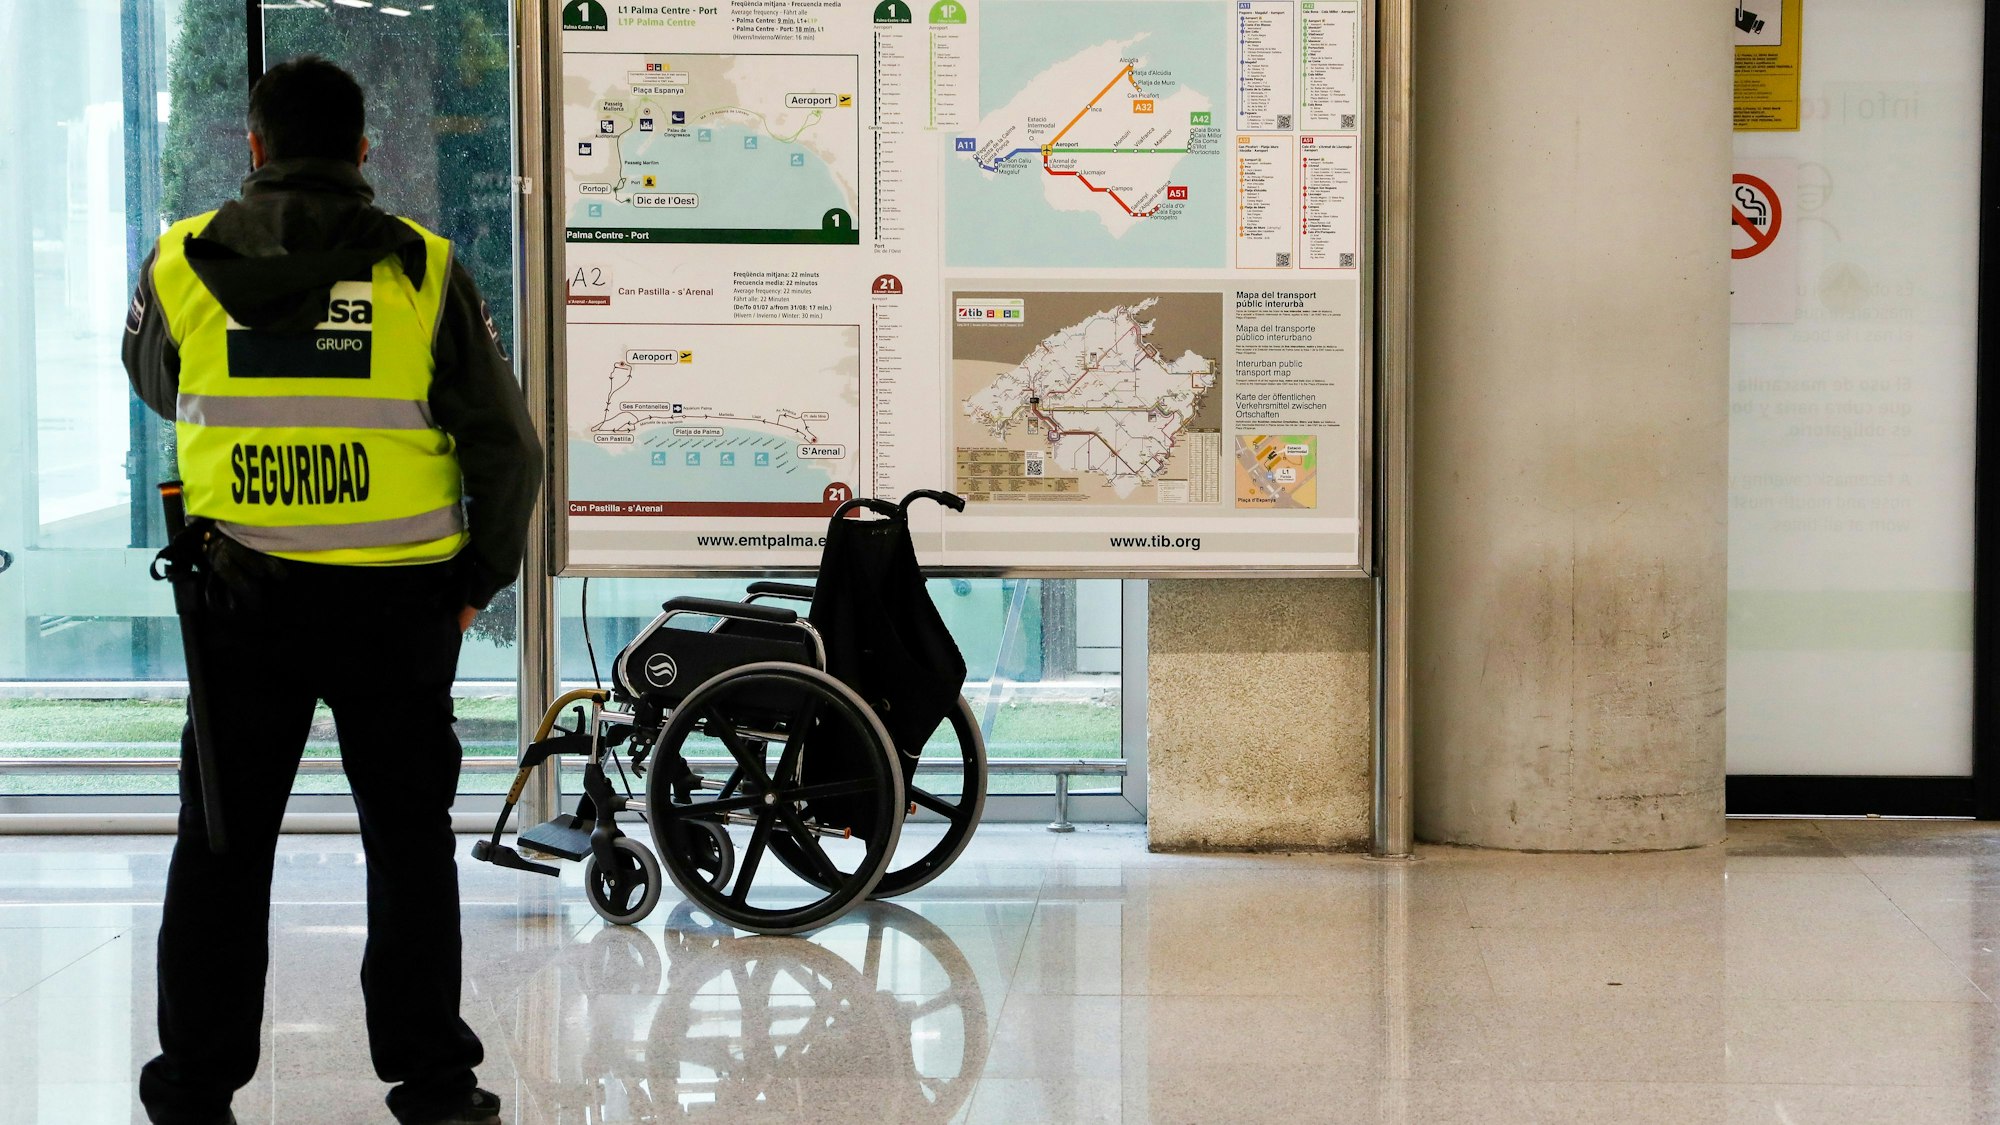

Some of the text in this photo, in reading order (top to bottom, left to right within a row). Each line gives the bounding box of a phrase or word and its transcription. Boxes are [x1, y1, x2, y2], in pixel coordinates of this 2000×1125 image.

[577, 2, 589, 22] 1
[619, 6, 718, 15] L1 Palma Centre Port
[887, 3, 896, 18] 1
[637, 18, 665, 26] Palma
[667, 18, 696, 26] Centre
[633, 87, 684, 95] Plaça Espanya
[791, 95, 832, 106] Aeroport
[1135, 103, 1152, 111] A32
[1192, 115, 1209, 123] A42
[957, 141, 974, 150] A11
[1055, 141, 1079, 149] Aeroport
[1169, 189, 1186, 197] A51
[637, 196, 695, 205] Dic de l'Oest
[831, 213, 840, 228] 1
[566, 230, 649, 241] Palma Centre Port
[879, 277, 896, 290] 21
[618, 287, 714, 296] Can Pastilla s'Arenal
[1236, 291, 1316, 300] Mapa del transport
[1236, 299, 1304, 309] públic interurbà
[968, 308, 983, 317] tib
[1235, 324, 1316, 333] Mapa del transporte
[1235, 333, 1312, 342] público interurbano
[316, 338, 363, 351] GRUPO
[632, 352, 673, 362] Aeroport
[1235, 359, 1303, 369] Interurban public
[1235, 369, 1271, 377] transport
[1235, 392, 1316, 401] Karte der öffentlichen
[1235, 401, 1327, 410] Verkehrsmittel zwischen
[1235, 410, 1280, 418] Ortschaften
[802, 447, 841, 456] S'Arenal
[231, 441, 370, 506] SEGURIDAD
[828, 487, 845, 501] 21
[569, 503, 663, 512] Can Pastilla s'Arenal
[1110, 535, 1201, 550] www.tib.org
